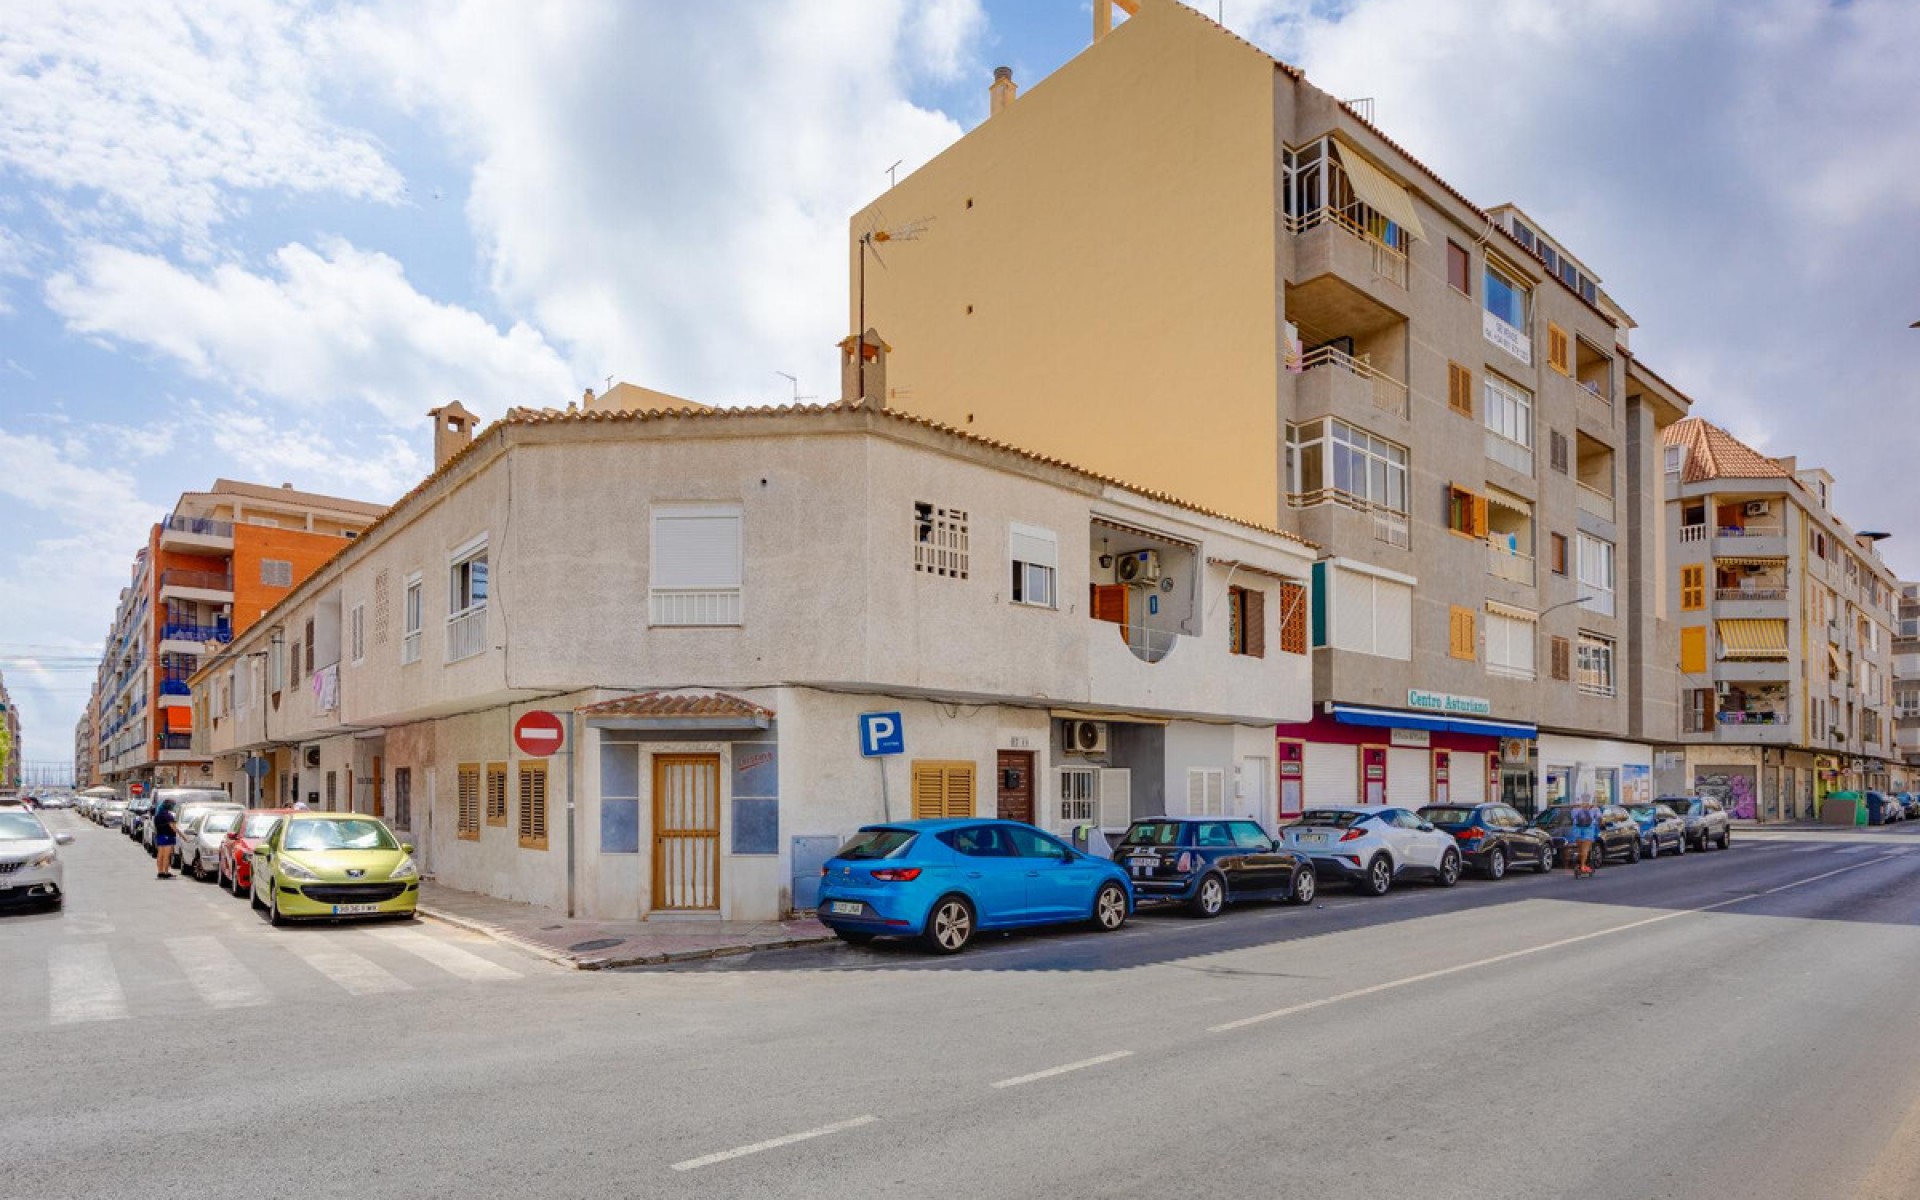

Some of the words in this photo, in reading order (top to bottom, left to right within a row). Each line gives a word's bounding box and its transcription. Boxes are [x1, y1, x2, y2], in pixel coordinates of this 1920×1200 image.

[1410, 690, 1442, 709] Centro
[1445, 695, 1489, 713] Asturiano
[868, 717, 894, 751] P
